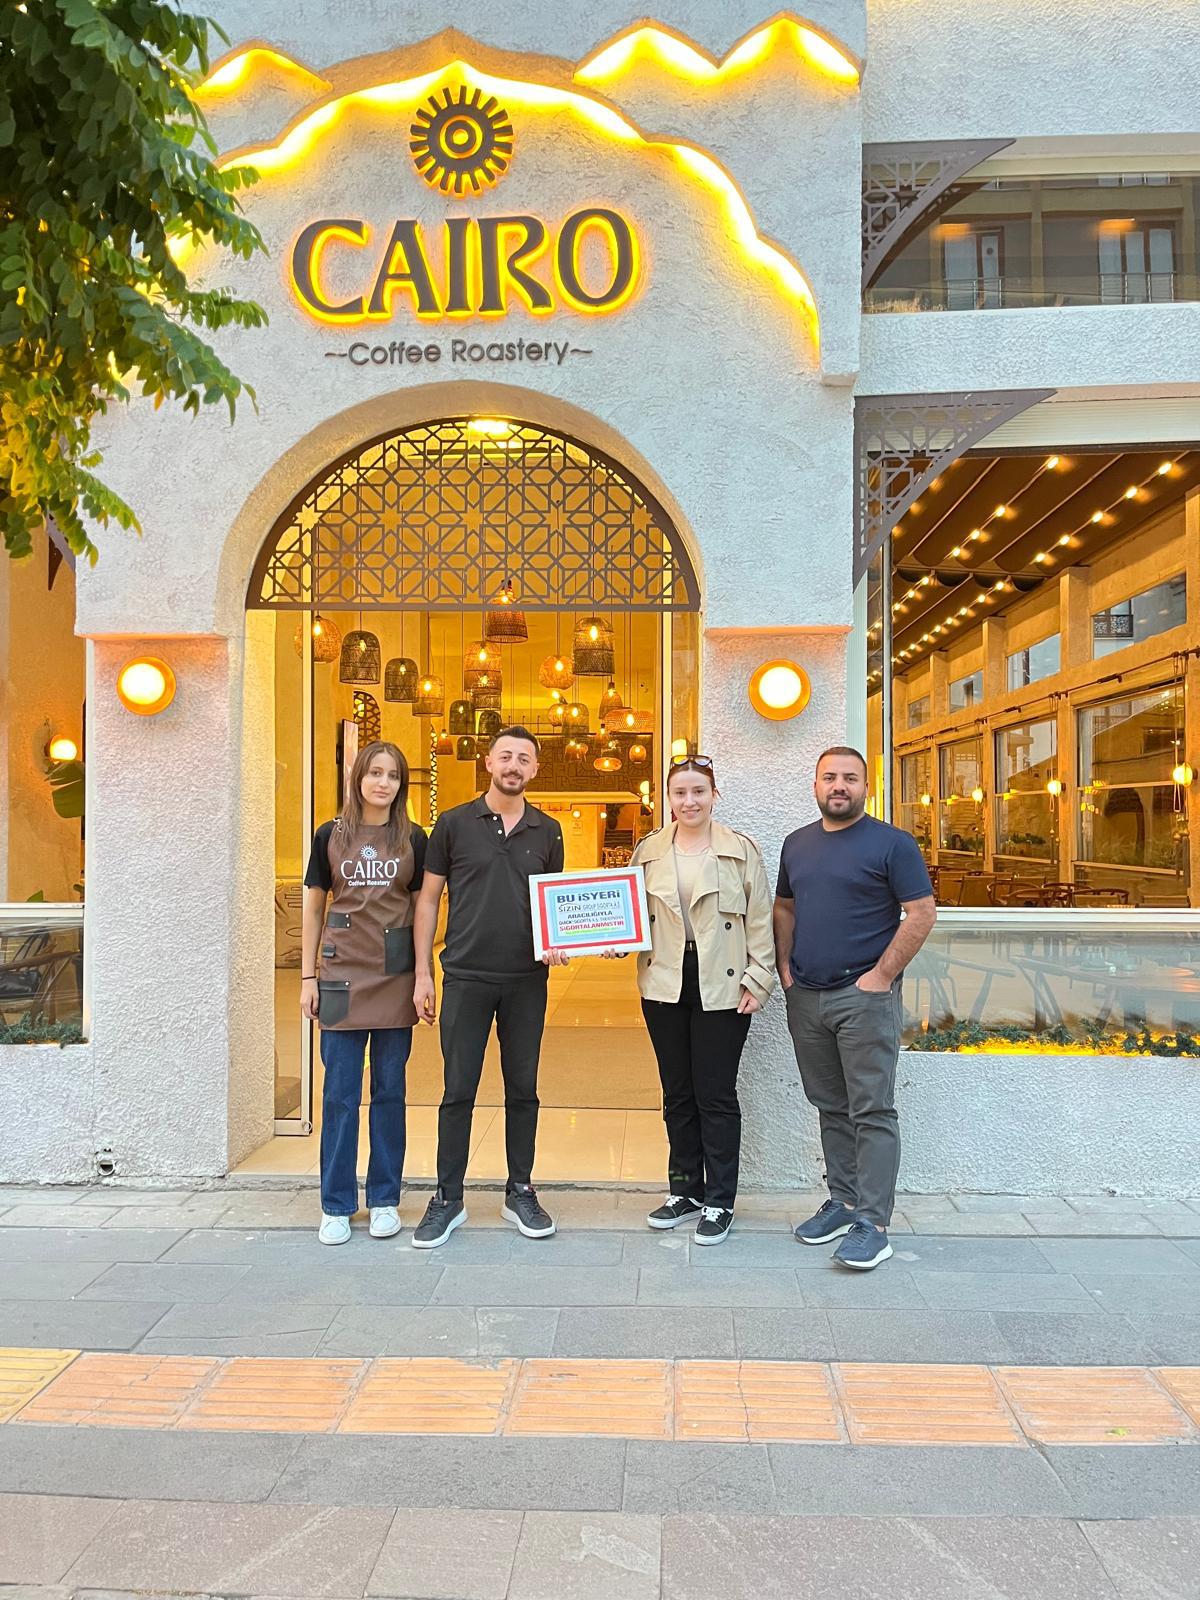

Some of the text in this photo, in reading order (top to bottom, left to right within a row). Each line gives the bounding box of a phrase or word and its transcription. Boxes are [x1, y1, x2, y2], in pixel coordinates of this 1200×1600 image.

[292, 207, 637, 318] CAIRO
[340, 860, 398, 880] CAIRO
[557, 894, 575, 903] BU
